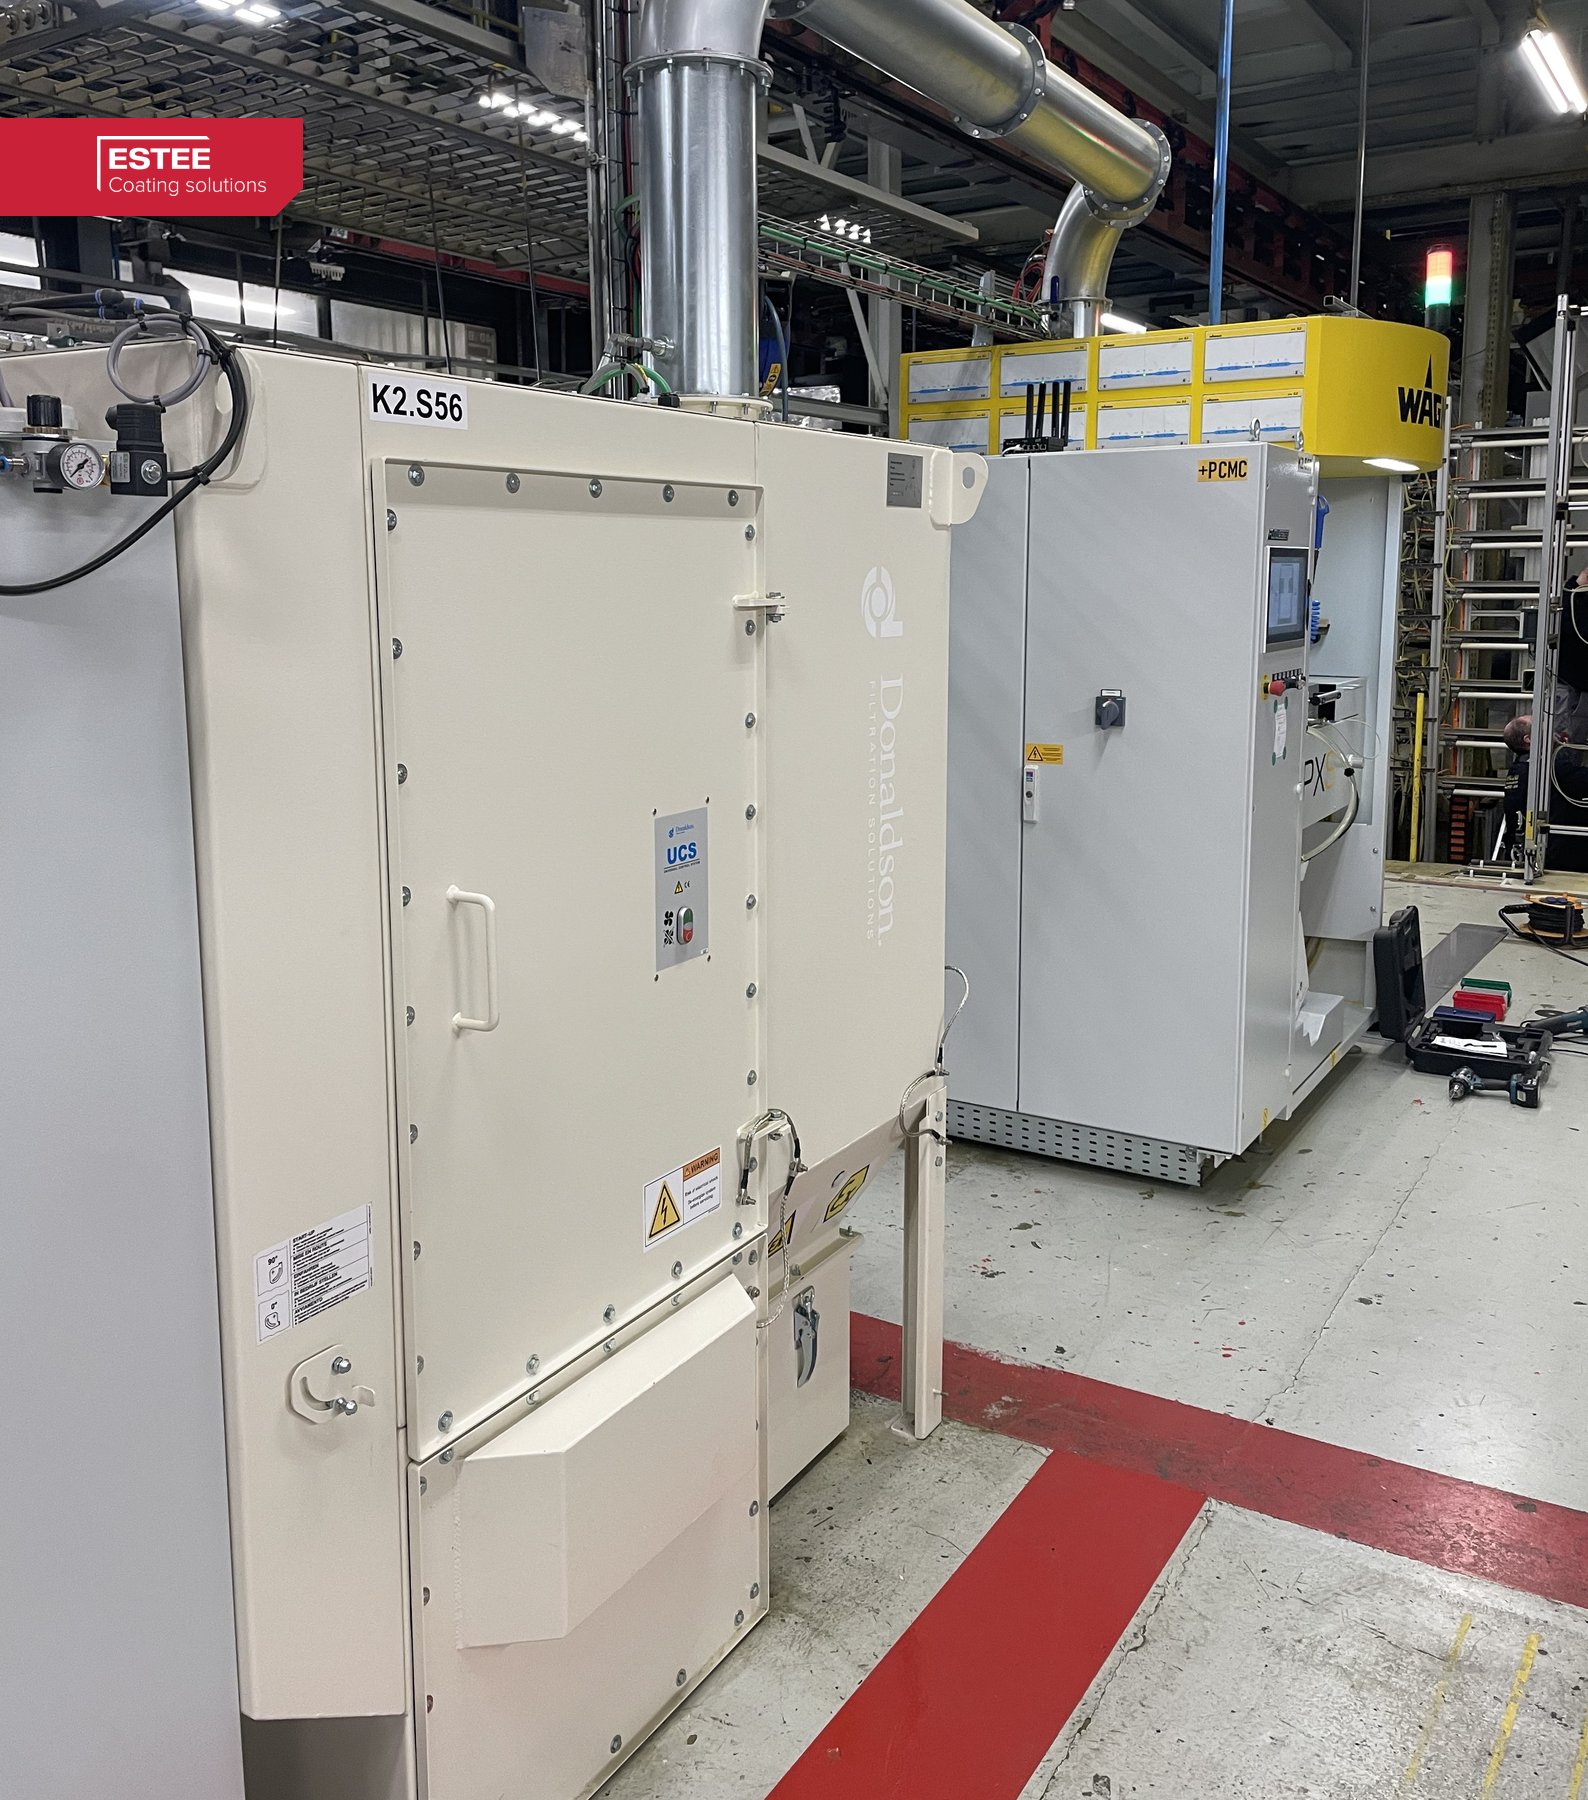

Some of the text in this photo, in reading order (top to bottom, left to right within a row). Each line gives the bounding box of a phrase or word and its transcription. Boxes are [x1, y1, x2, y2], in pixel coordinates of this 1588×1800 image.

[372, 383, 463, 422] K2.S56
[1198, 460, 1248, 479] +PCMC
[866, 680, 877, 940] FILTRATION SOLUTIONS
[667, 842, 697, 865] UCS
[691, 1153, 718, 1173] WARNING
[293, 1229, 315, 1243] START-UP
